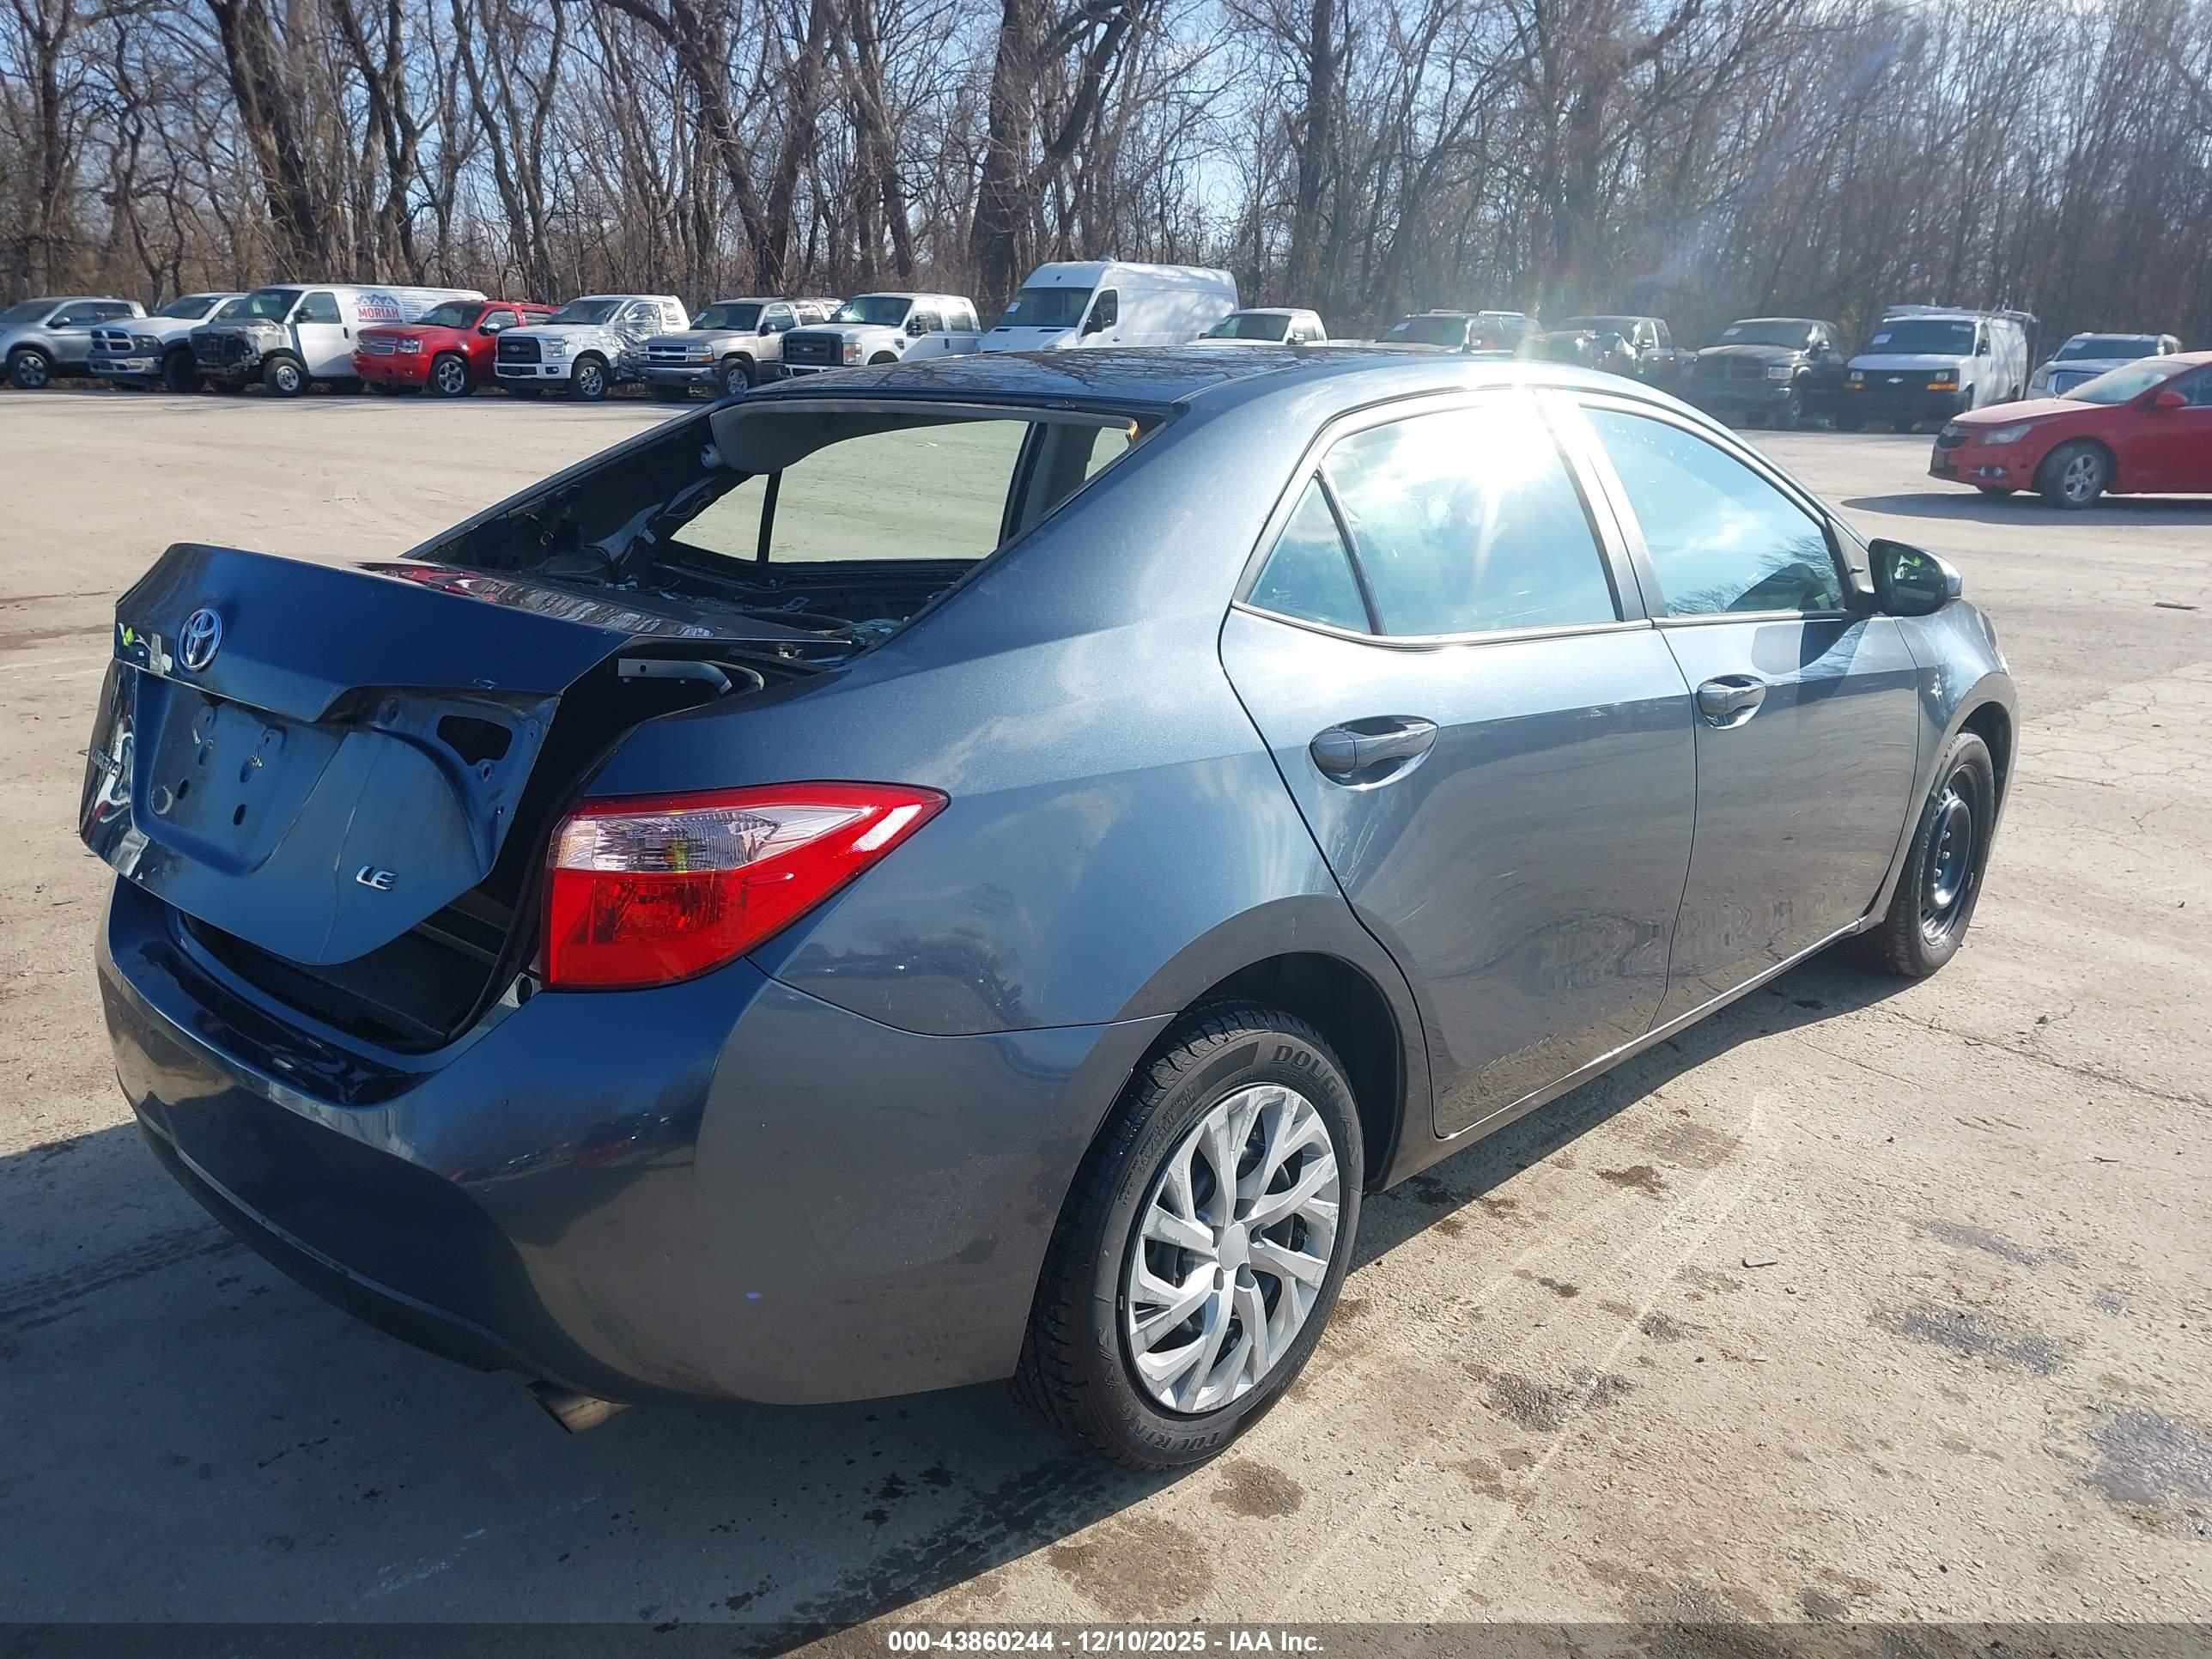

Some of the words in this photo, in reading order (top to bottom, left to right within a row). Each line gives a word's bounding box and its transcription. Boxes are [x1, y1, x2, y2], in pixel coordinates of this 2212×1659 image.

[358, 307, 399, 319] MORIAH
[356, 865, 398, 890] LE
[1271, 1044, 1359, 1168] DOUGLAS
[1118, 1401, 1220, 1452] TOURING
